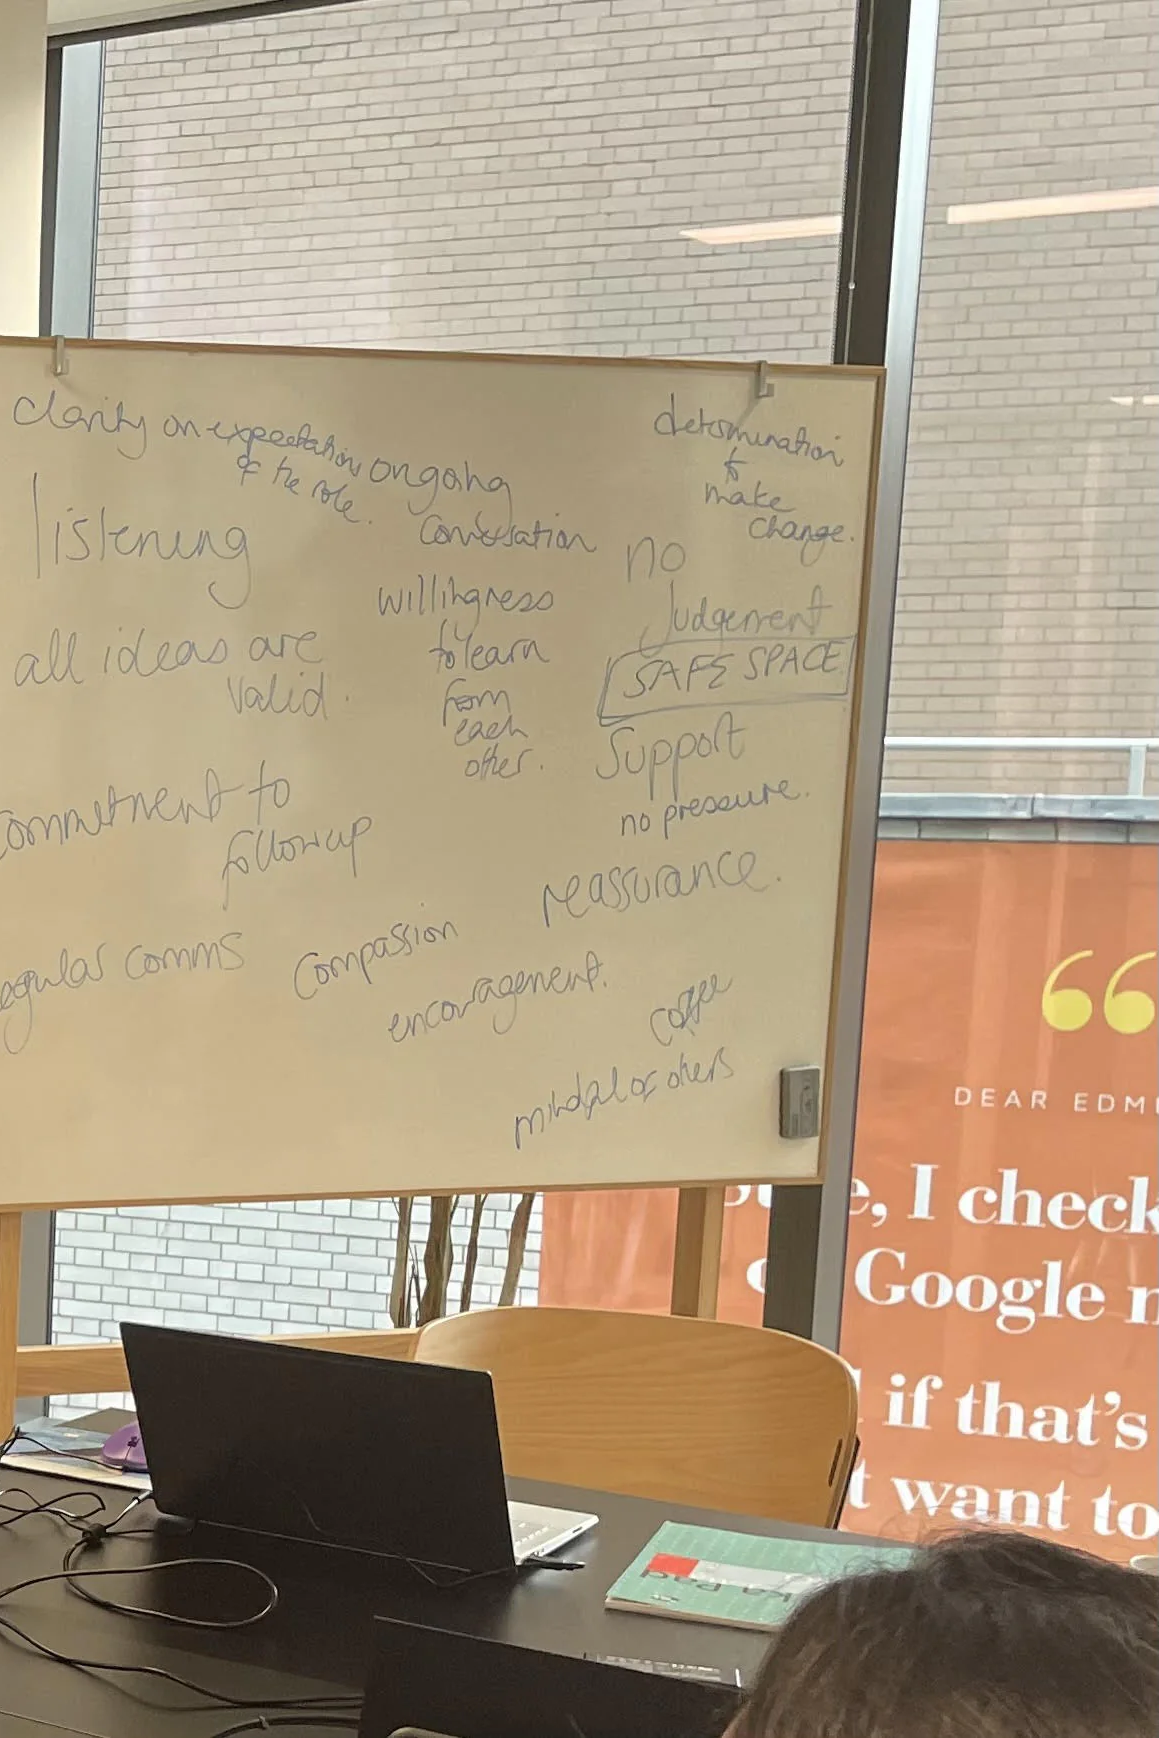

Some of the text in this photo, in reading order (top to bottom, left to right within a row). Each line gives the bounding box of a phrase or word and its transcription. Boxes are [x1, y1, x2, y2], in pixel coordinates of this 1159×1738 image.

[704, 480, 797, 514] make
[32, 471, 252, 611] listening
[626, 536, 686, 584] no
[14, 626, 324, 688] all ideas are
[464, 632, 551, 672] learn
[622, 640, 848, 699] SAFE SPACE
[453, 714, 530, 748] each
[247, 759, 292, 826] to
[620, 811, 651, 837] no
[953, 1086, 1159, 1116] DEAR EDM
[907, 1162, 940, 1220] I
[854, 1246, 1106, 1335] Google
[882, 1373, 943, 1430] if
[890, 1480, 1071, 1532] want
[1091, 1483, 1159, 1540] to
